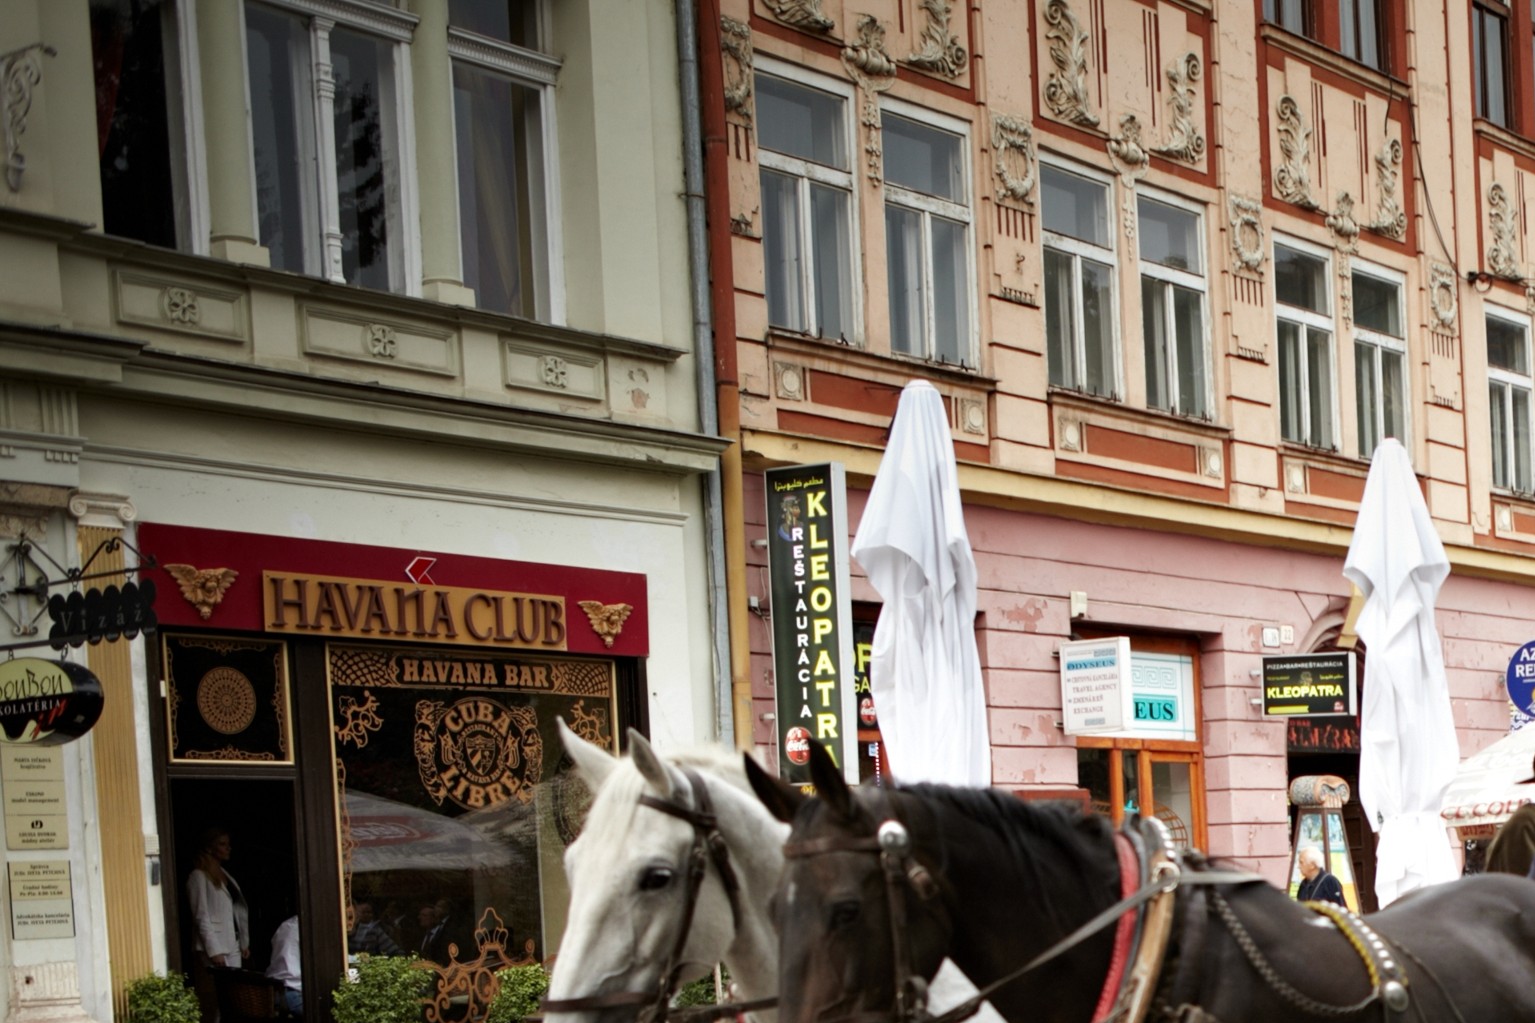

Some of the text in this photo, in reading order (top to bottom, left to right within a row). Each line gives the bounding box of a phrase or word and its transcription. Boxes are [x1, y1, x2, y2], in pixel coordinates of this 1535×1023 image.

[60, 602, 143, 633] Vizáž
[464, 592, 566, 645] CLUB
[791, 527, 813, 719] REŠTAURÁCIA
[402, 658, 550, 688] HAVANA BAR
[1267, 684, 1344, 699] KLEOPATRA
[444, 701, 511, 737] CUBA
[1134, 701, 1174, 721] EUS
[440, 764, 521, 809] LIBRE
